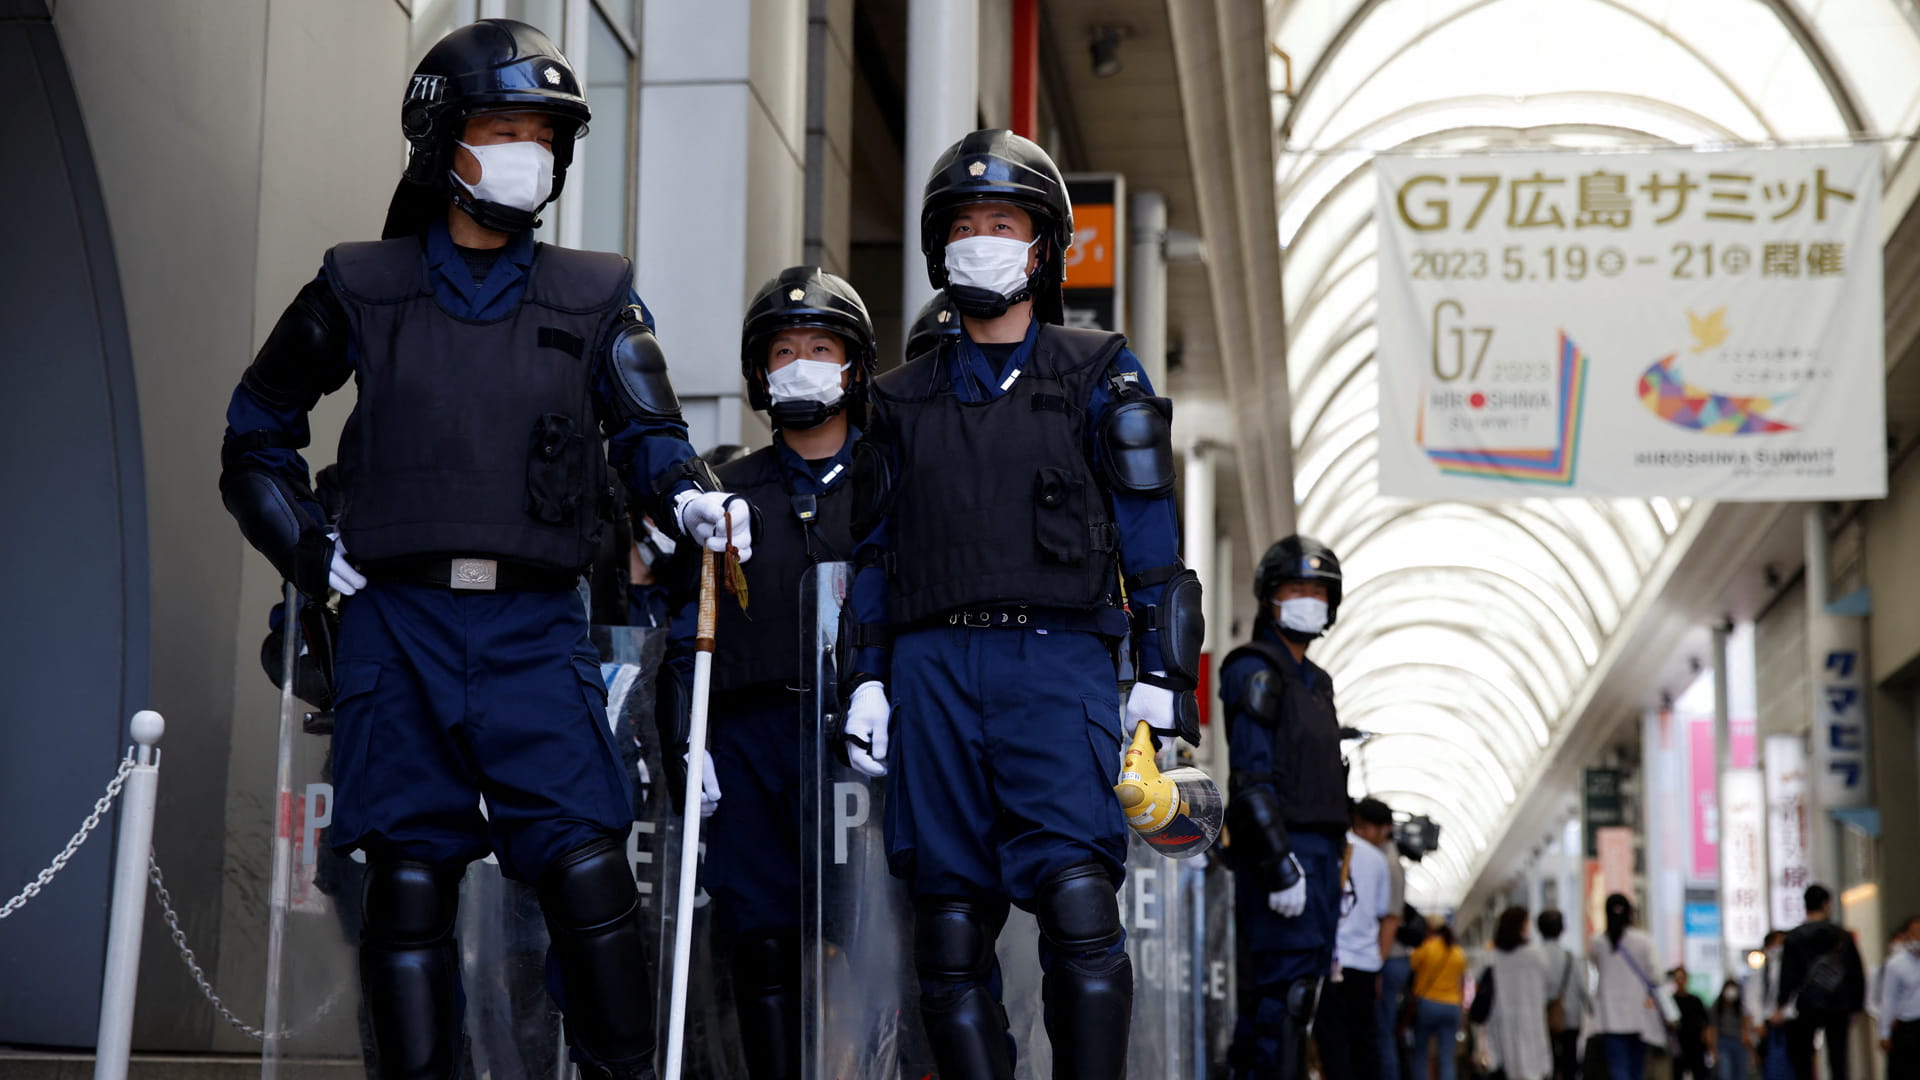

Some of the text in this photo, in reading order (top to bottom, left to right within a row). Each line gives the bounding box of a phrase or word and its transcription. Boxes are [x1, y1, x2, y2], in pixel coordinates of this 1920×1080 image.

[410, 76, 438, 100] 711
[1397, 166, 1854, 231] G7広島サミット
[1410, 249, 1489, 280] 2023
[1761, 241, 1846, 280] 開催
[1431, 298, 1495, 383] G7
[1825, 650, 1863, 789] クマヒラ
